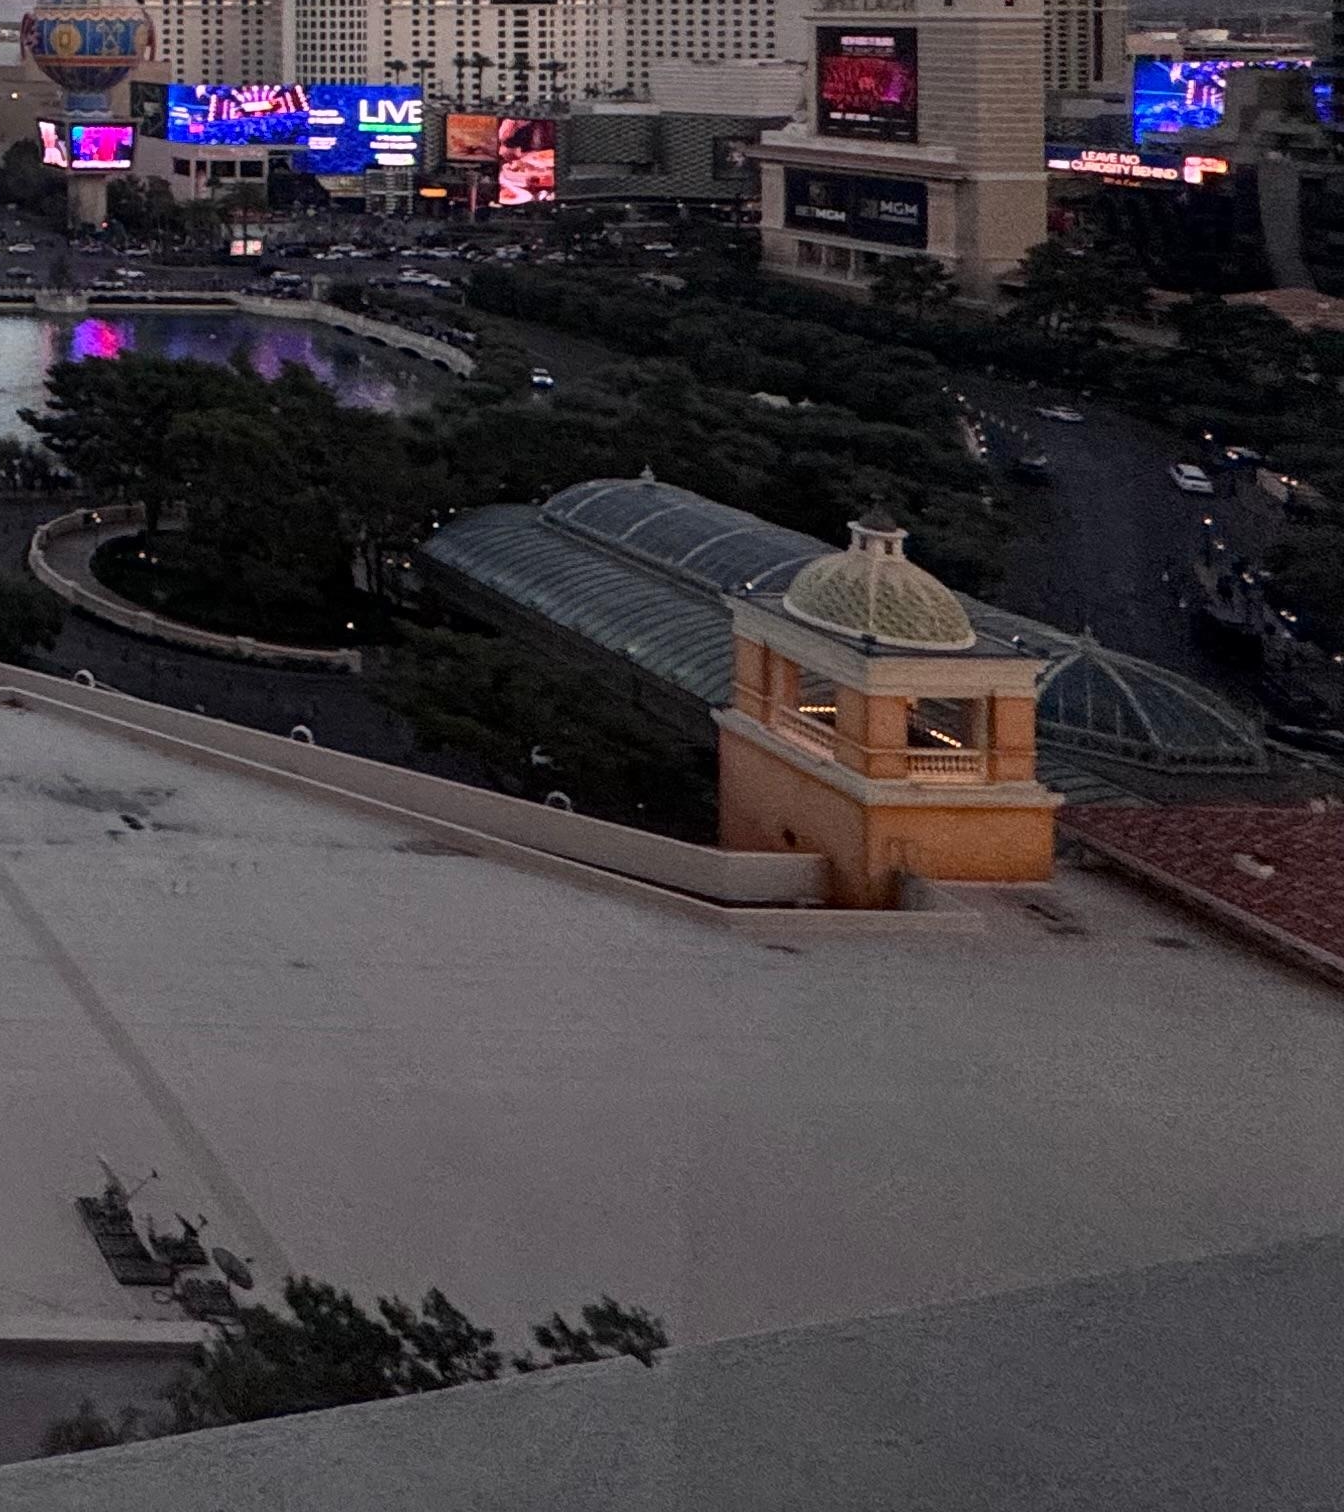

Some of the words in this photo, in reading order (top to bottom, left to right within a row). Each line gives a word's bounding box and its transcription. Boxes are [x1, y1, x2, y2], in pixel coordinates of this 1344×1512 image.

[358, 99, 422, 123] LIVE
[1081, 151, 1119, 164] LEAVE
[1120, 154, 1141, 165] NO
[1071, 160, 1131, 175] CURIOSITY
[1132, 165, 1179, 180] BEHIND
[880, 200, 919, 216] MGM
